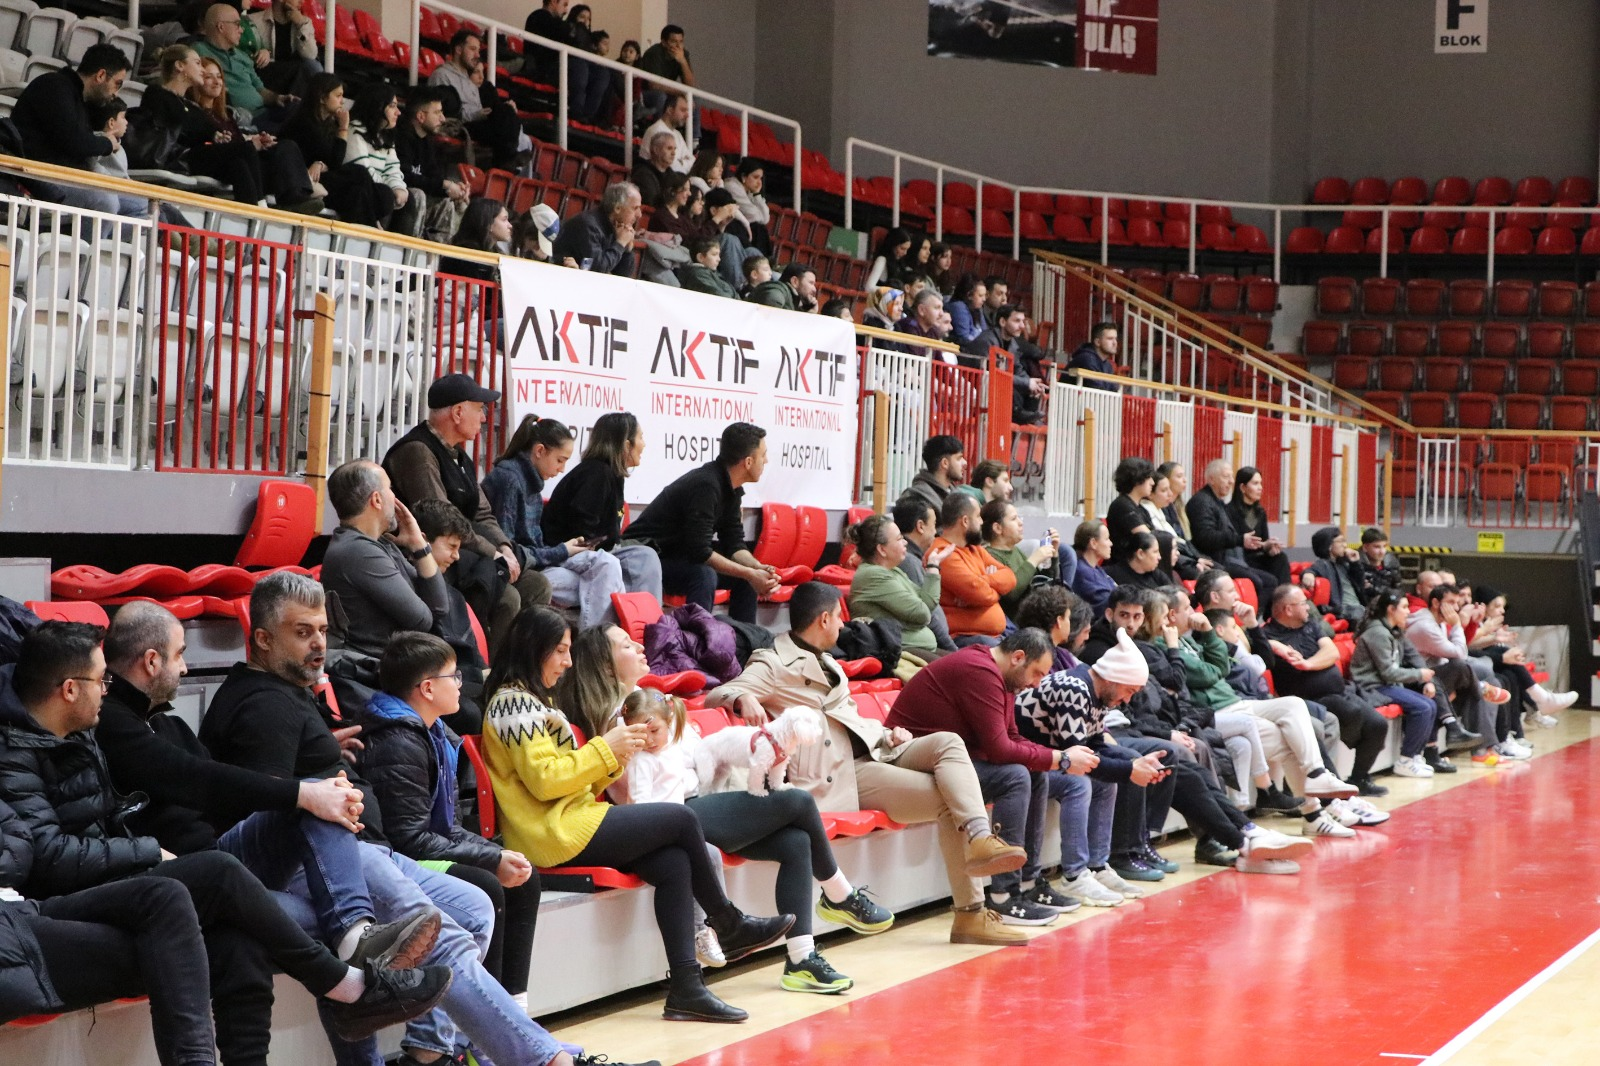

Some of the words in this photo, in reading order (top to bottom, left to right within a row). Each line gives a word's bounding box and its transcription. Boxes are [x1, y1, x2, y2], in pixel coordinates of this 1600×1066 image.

[1084, 21, 1137, 58] ULAŞ
[1440, 35, 1481, 47] BLOK
[516, 378, 624, 411] NTERNATIONAL
[651, 391, 755, 423] INTERNATIONAL
[775, 404, 842, 432] INTERNATIONAL
[664, 432, 723, 462] HOSPI
[781, 442, 832, 471] HOSPITAL
